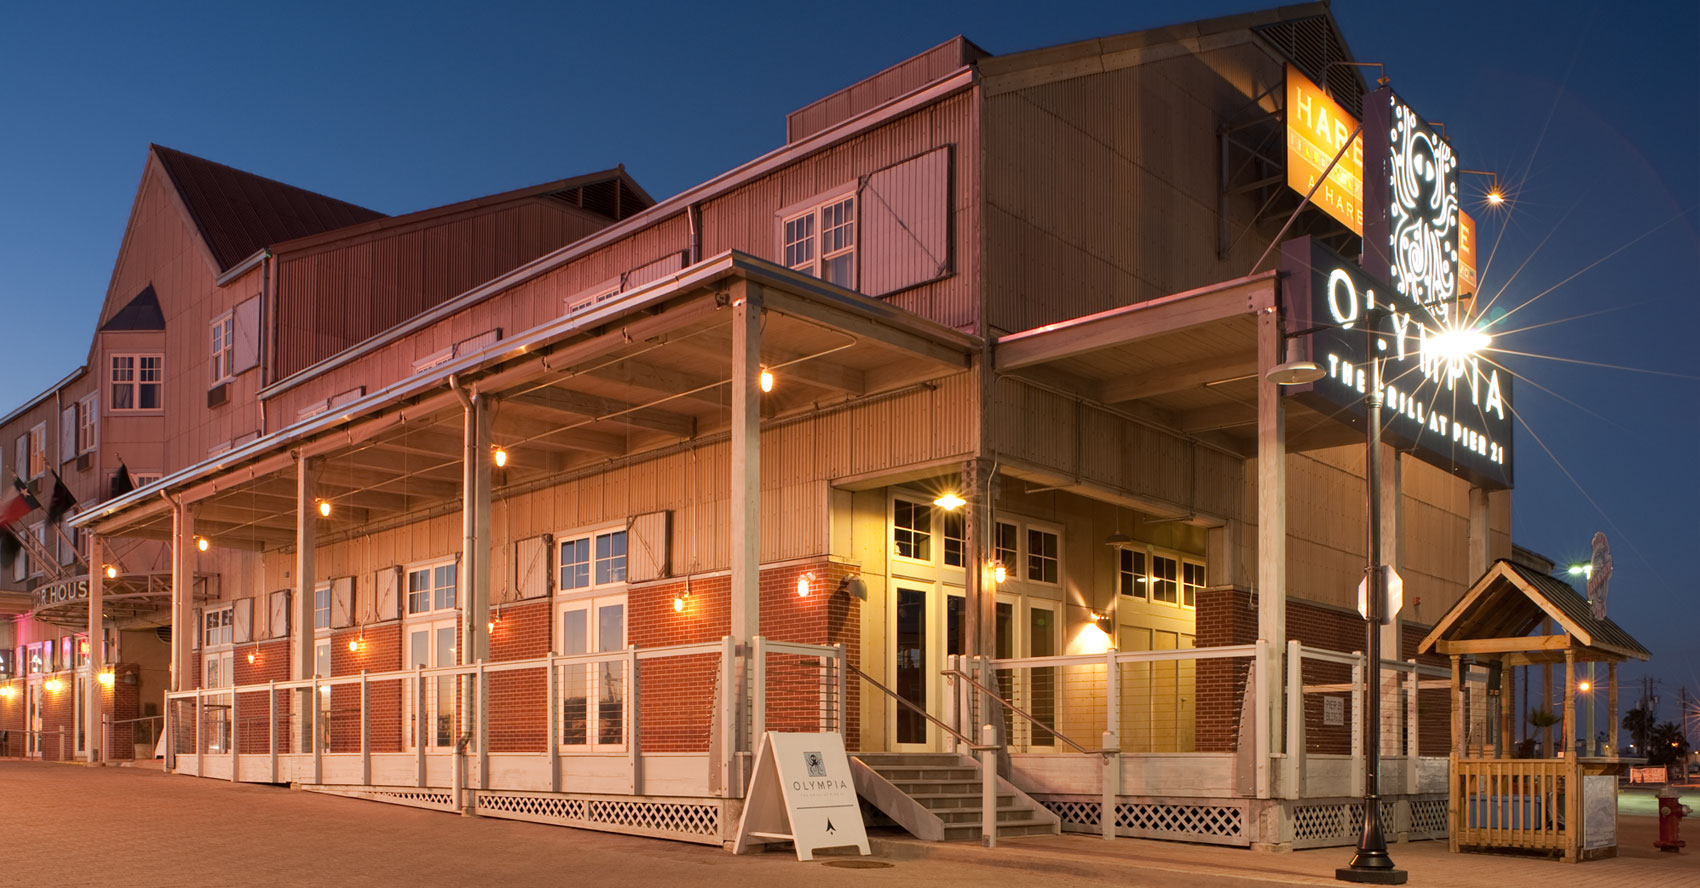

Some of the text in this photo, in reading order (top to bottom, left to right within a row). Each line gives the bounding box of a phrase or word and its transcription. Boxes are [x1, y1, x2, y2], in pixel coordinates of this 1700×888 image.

[1308, 175, 1315, 188] A
[1328, 353, 1504, 465] THE RILL AT PIER 21
[50, 581, 88, 603] HOUS
[793, 780, 847, 790] OLYMPIA
